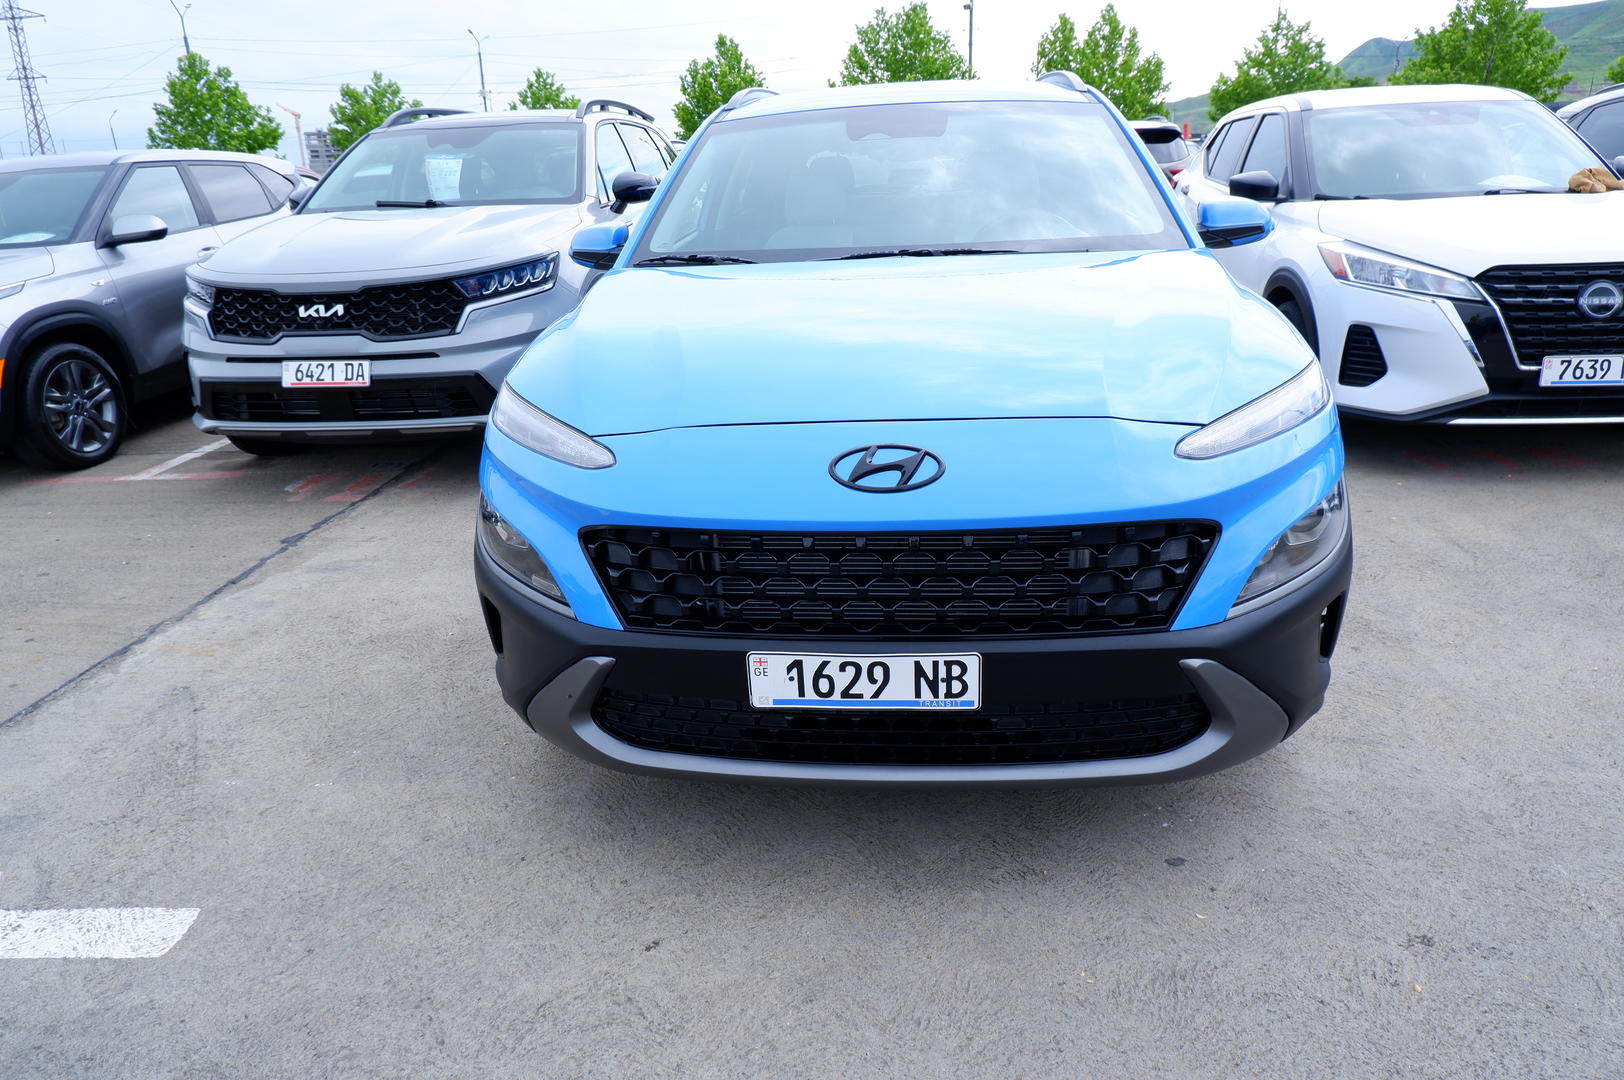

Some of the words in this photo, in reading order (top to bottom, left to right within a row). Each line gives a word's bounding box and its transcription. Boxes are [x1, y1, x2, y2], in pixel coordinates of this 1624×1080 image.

[1580, 297, 1621, 305] NISSAN
[295, 363, 335, 381] 6421
[344, 363, 365, 381] DA
[1559, 359, 1612, 380] 7639
[754, 667, 768, 676] GE
[786, 659, 891, 699] 1629
[914, 660, 969, 699] NB
